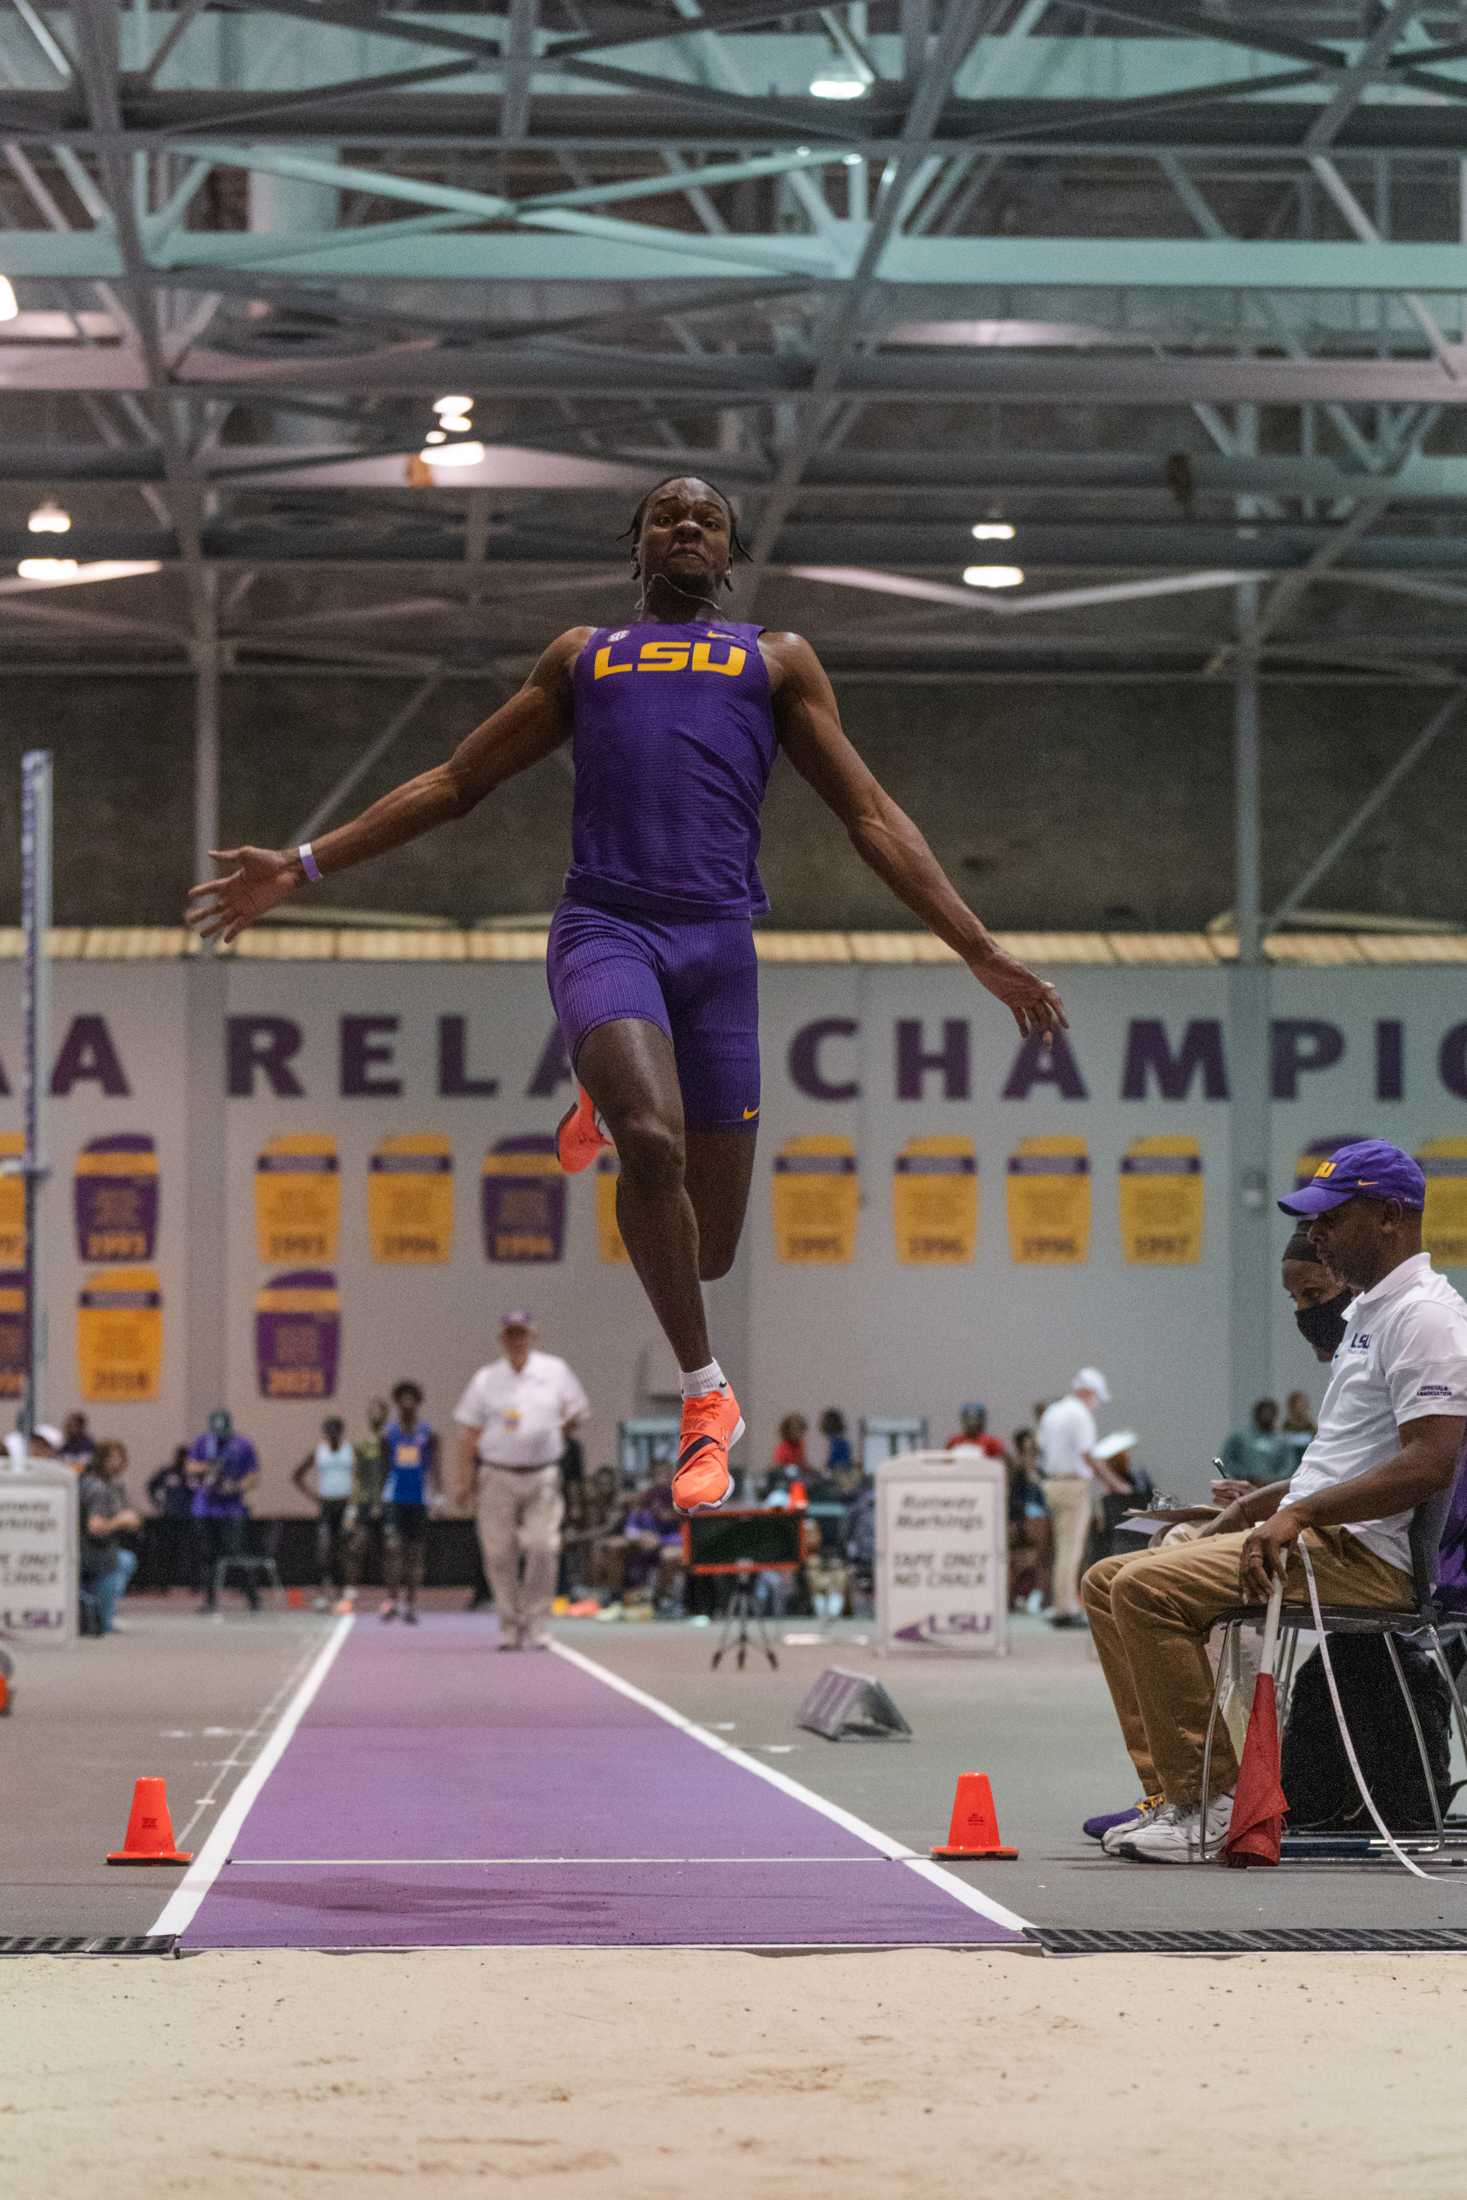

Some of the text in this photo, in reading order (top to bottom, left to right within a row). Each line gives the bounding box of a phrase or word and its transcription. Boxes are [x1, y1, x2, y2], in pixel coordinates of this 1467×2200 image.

[594, 641, 747, 681] LSU
[1314, 1161, 1338, 1178] SU
[902, 1495, 979, 1511] Runway
[896, 1515, 984, 1532] Markings
[943, 1553, 989, 1567] ONLY
[926, 1573, 986, 1588] CHALK
[2, 1610, 64, 1630] LSU
[927, 1614, 992, 1635] LSU
